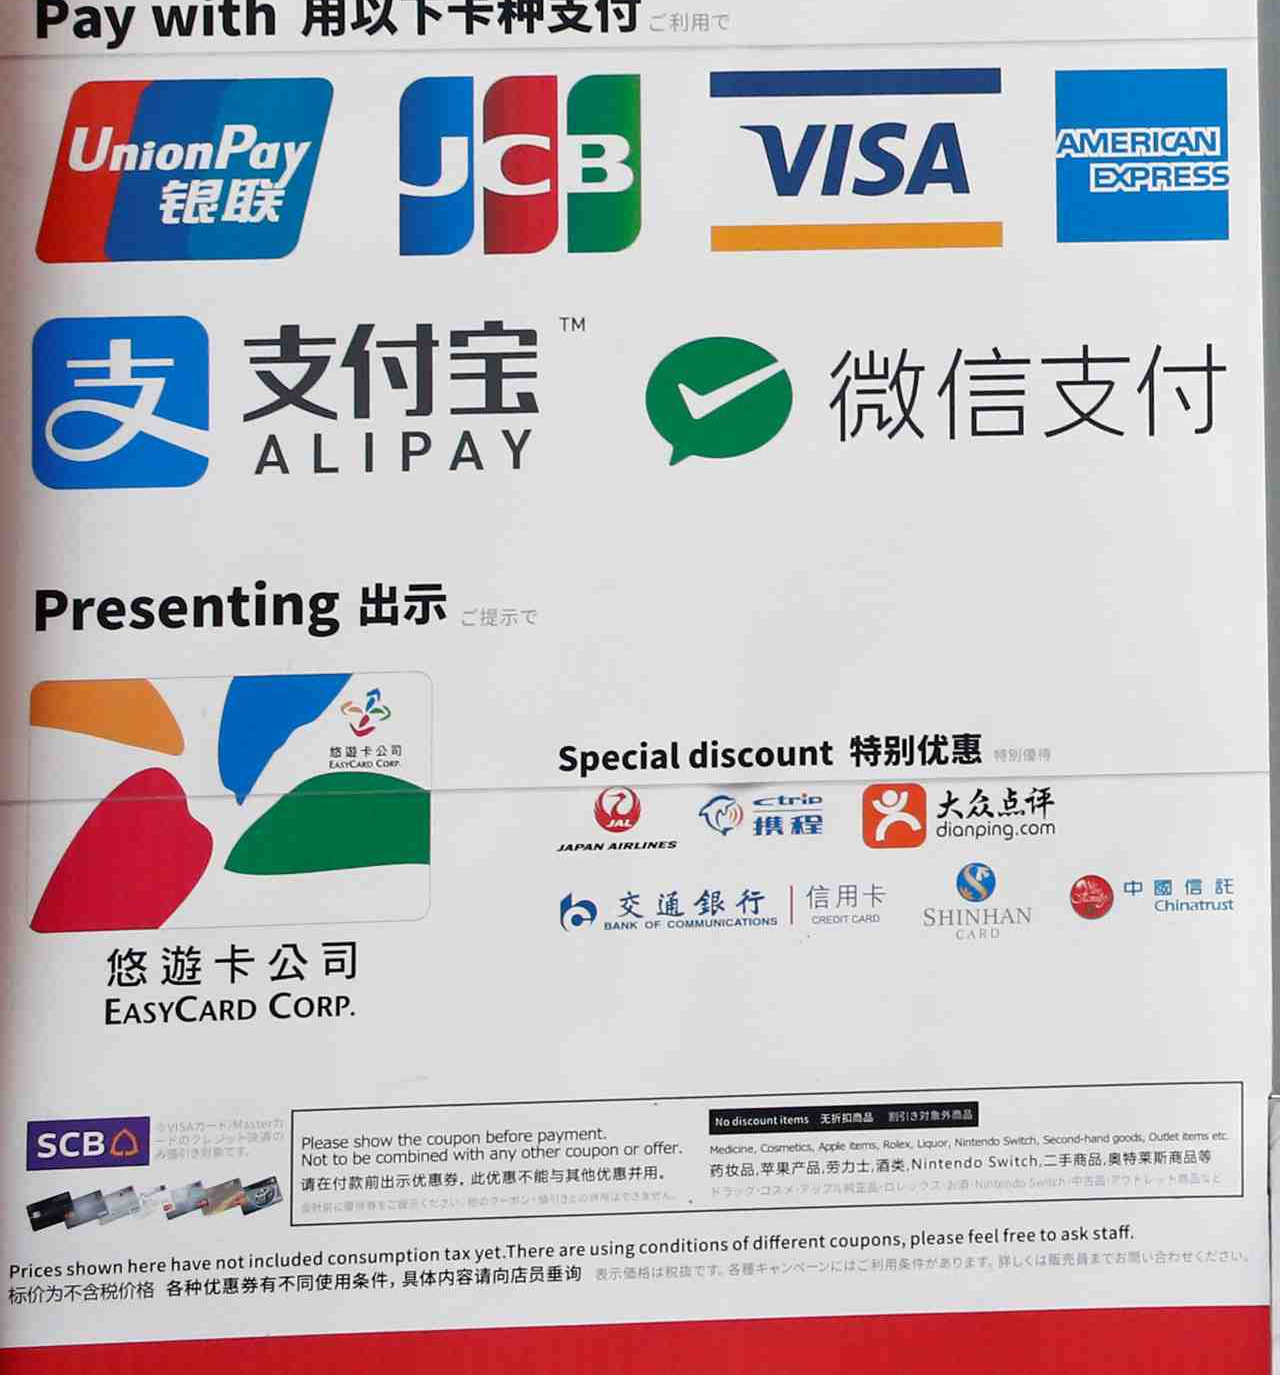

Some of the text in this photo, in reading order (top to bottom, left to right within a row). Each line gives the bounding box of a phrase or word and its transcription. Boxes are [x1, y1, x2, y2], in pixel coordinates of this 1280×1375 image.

[649, 12, 730, 33] ご利用で
[66, 122, 312, 186] UnionPay
[1057, 128, 1218, 156] AMERICAN
[399, 133, 635, 198] JCB
[739, 121, 971, 197] VISA
[1093, 162, 1230, 190] EXPRESS
[158, 178, 287, 227] 银联
[242, 319, 540, 423] 支付宝
[829, 343, 1227, 443] 微信支付
[254, 428, 532, 475] ALIPAY
[34, 579, 340, 638] Presenting
[359, 582, 447, 627] 出示
[461, 607, 537, 627] ご提示で
[558, 739, 834, 778] Special discount
[849, 732, 983, 768] 特别优惠
[935, 785, 1056, 821] 大众点评
[934, 821, 1057, 841] dianping.com
[556, 840, 678, 852] JAPAN AIRLINES
[805, 883, 887, 910] 信用卡
[1123, 878, 1233, 897] 中國信託
[616, 887, 768, 919] 交通銀行
[923, 907, 1032, 927] SHINHAN
[1153, 898, 1234, 913] Chinatrust
[603, 917, 780, 931] BANK OF COMMUNICATIONS
[811, 913, 881, 925] CREDIT CARD
[955, 927, 1000, 941] CARD
[106, 941, 357, 987] 悠遊卡公司
[715, 1114, 810, 1127] No discount items
[37, 1131, 105, 1159] SCB
[301, 1127, 607, 1150] Please show the coupon before payment.
[301, 1140, 683, 1167] Not to be combined with any other coupon or offer.
[9, 1263, 62, 1280] Prices
[66, 1261, 123, 1277] shown
[127, 1258, 167, 1274] here
[171, 1257, 212, 1272] have
[215, 1255, 245, 1270] not
[248, 1250, 323, 1269] included
[327, 1247, 440, 1267] consumption
[444, 1247, 471, 1261] tax
[559, 1245, 586, 1258] are
[590, 1241, 636, 1259] using
[639, 1237, 729, 1255] conditions
[732, 1235, 750, 1251] of
[752, 1234, 826, 1251] different
[829, 1235, 906, 1251] coupons,
[910, 1230, 964, 1250] please
[967, 1228, 999, 1244] feel
[1003, 1227, 1036, 1243] free
[1039, 1229, 1057, 1242] to
[1061, 1226, 1089, 1242] ask
[1092, 1224, 1134, 1241] staff.
[8, 1281, 155, 1306] 标价为不含税价格
